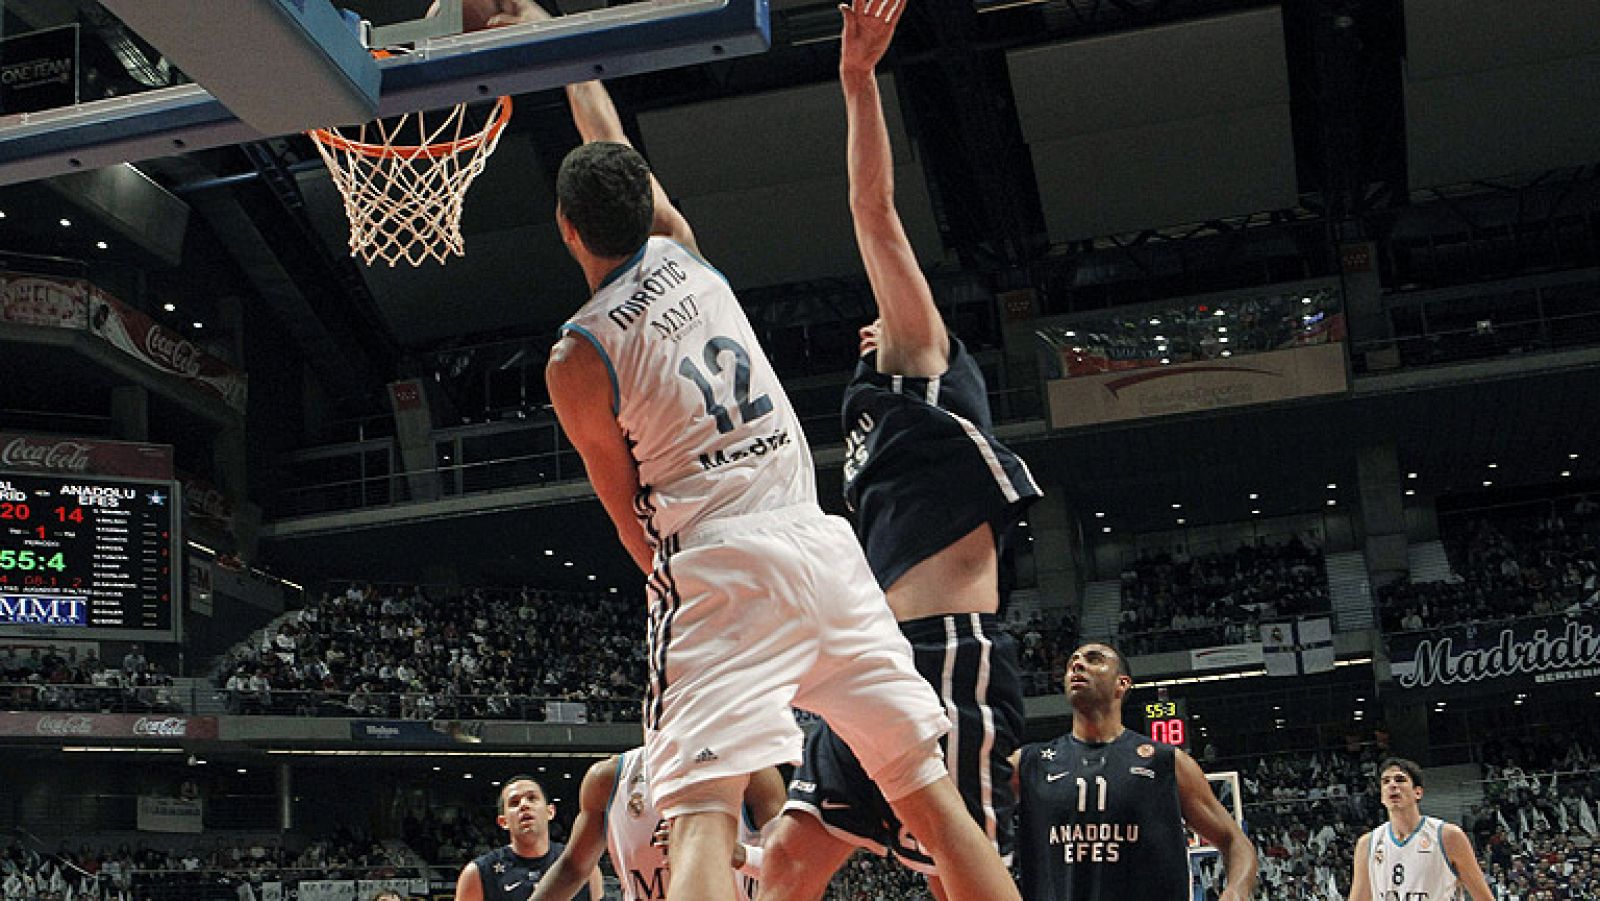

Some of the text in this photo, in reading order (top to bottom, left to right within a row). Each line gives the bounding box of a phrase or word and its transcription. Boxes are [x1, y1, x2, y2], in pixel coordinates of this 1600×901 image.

[650, 294, 702, 339] MMT
[679, 335, 774, 434] 12
[2, 437, 89, 471] Coca-Cola
[60, 485, 136, 499] ANADOLU
[0, 503, 30, 520] 20
[54, 506, 84, 524] 14
[35, 525, 46, 541] 1
[0, 597, 86, 618] MMT
[133, 716, 188, 736] Coca-Cola
[1076, 775, 1108, 812] 11
[1049, 823, 1139, 846] ANADOLU
[1063, 843, 1120, 864] EFES
[1393, 863, 1405, 886] 8
